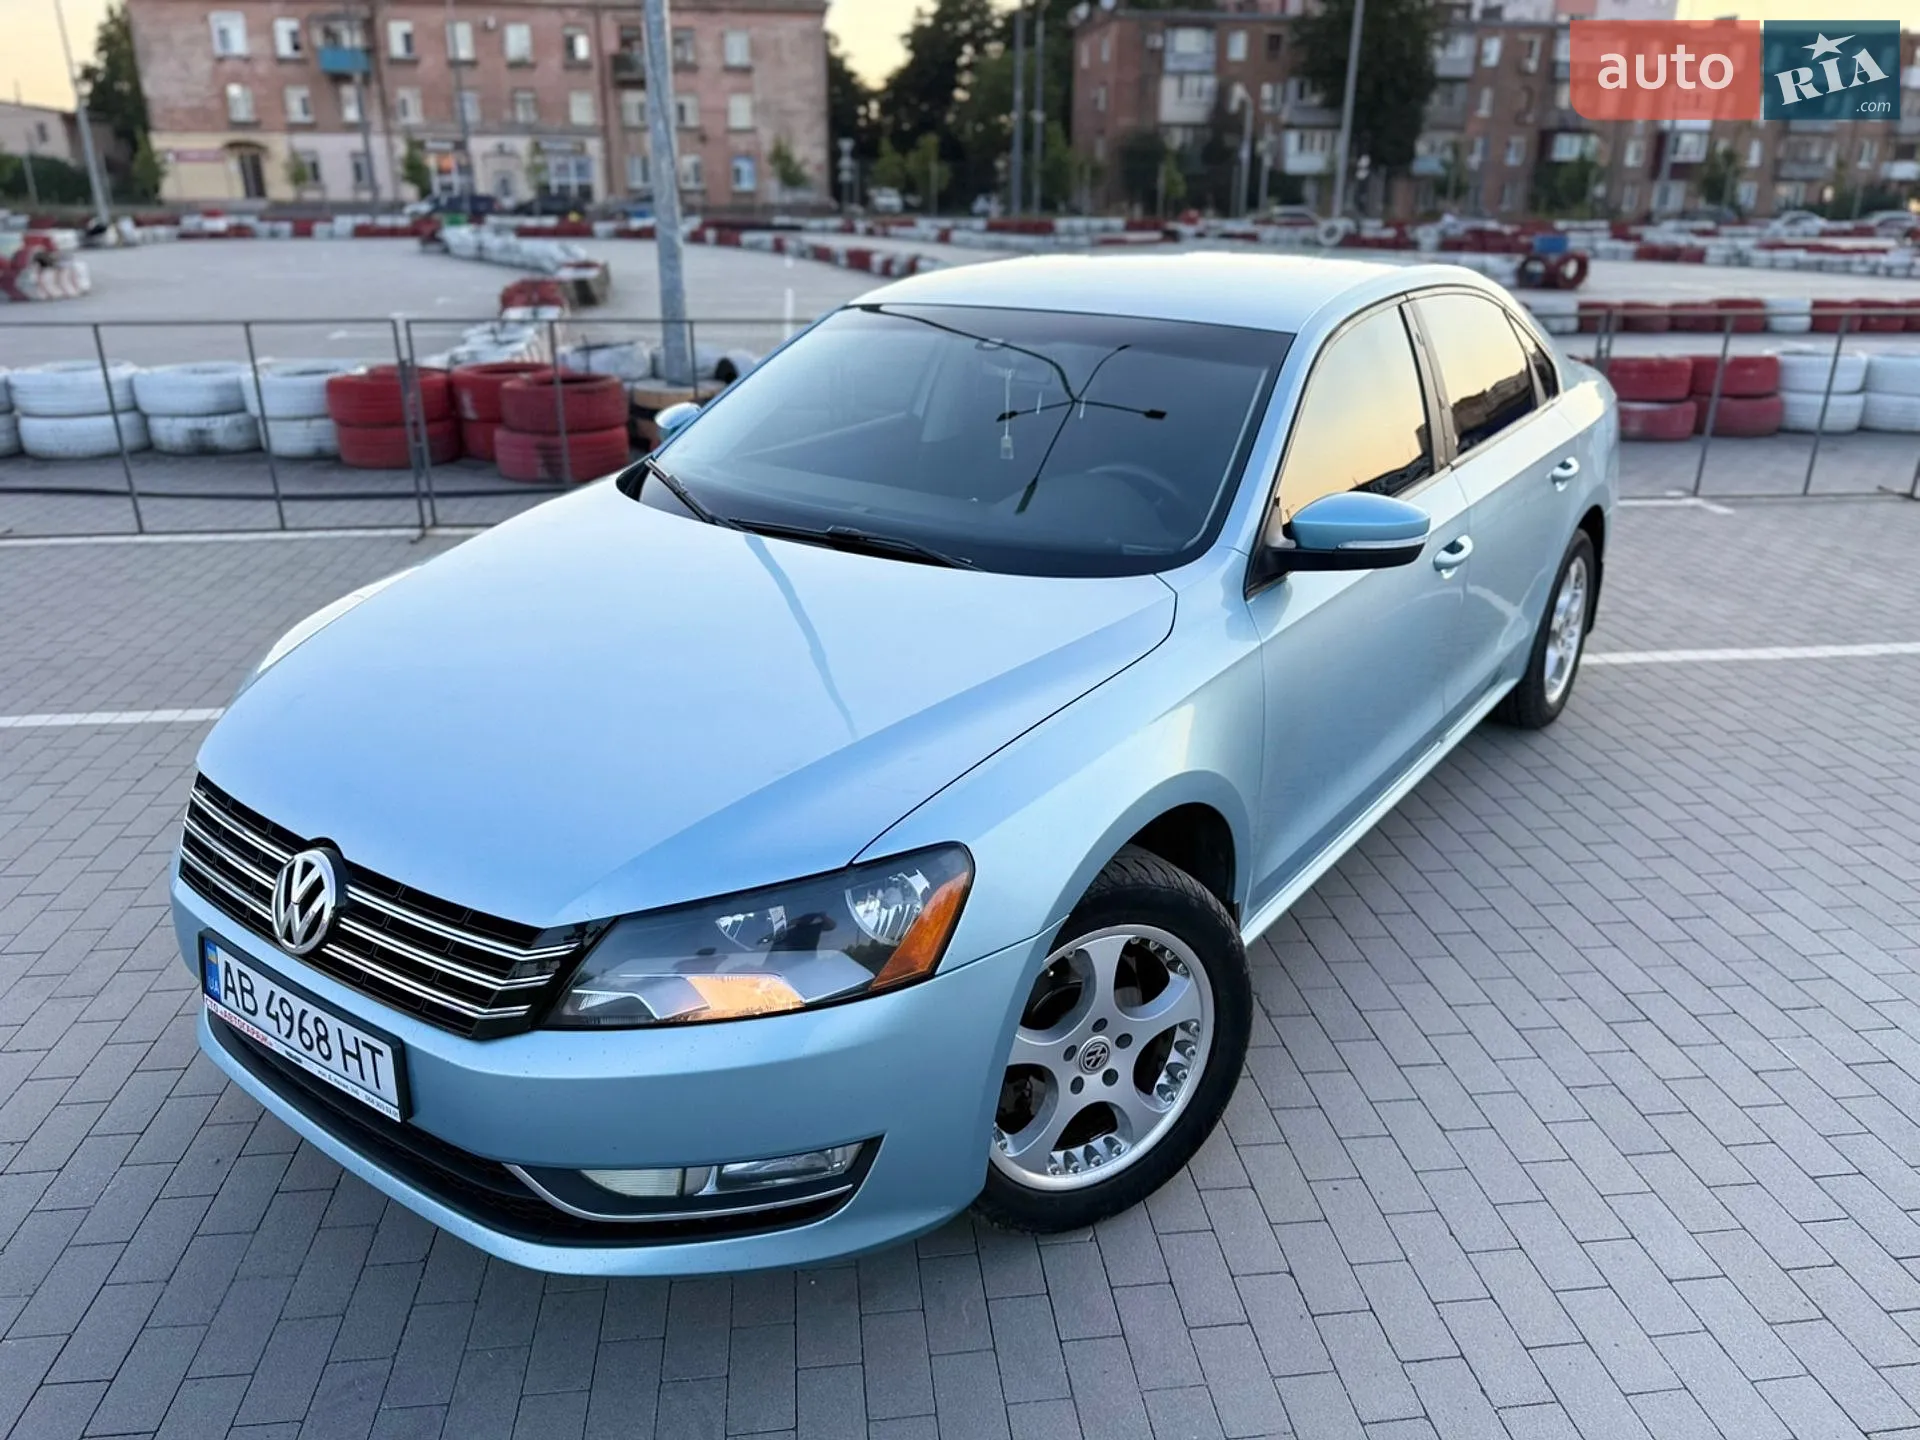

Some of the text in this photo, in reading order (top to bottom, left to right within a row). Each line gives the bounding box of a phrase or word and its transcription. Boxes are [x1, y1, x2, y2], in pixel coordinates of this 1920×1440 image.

[224, 960, 259, 1017] AB
[266, 989, 332, 1062] 4968
[337, 1027, 384, 1090] HT
